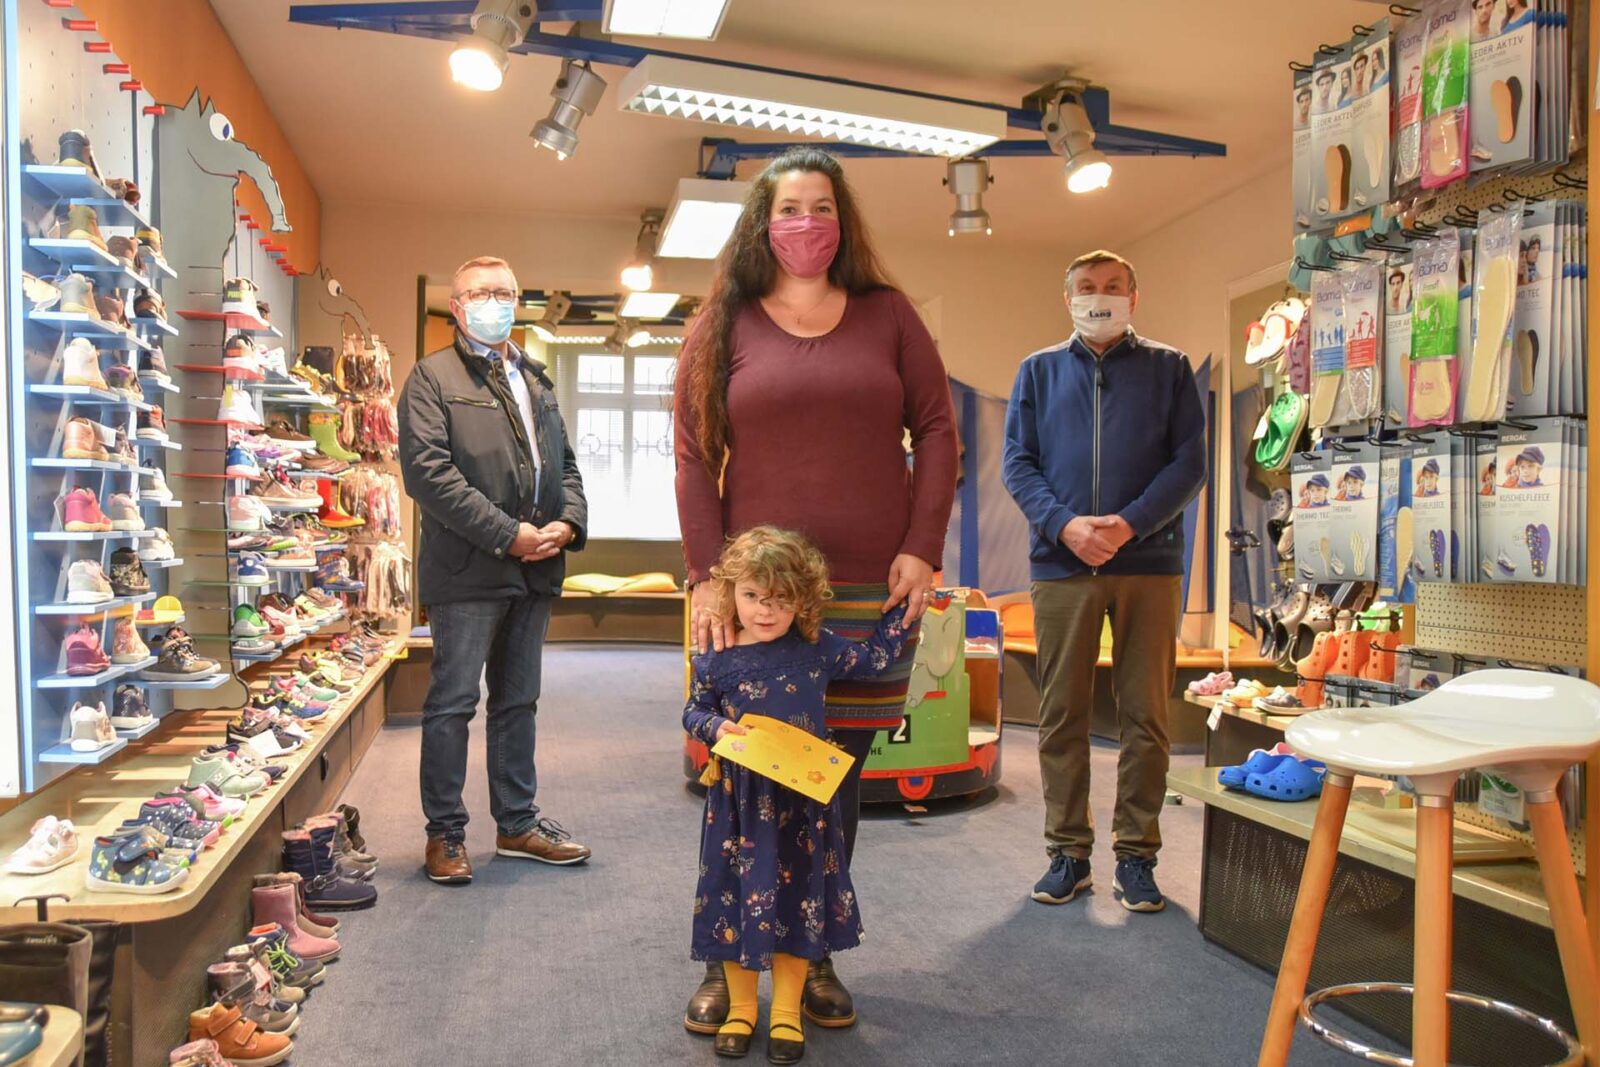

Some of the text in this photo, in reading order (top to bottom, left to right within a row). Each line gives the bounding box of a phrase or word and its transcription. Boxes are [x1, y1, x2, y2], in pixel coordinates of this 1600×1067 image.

[1496, 34, 1524, 50] AKTIV
[1501, 433, 1527, 443] BERGAL
[893, 718, 907, 741] 2
